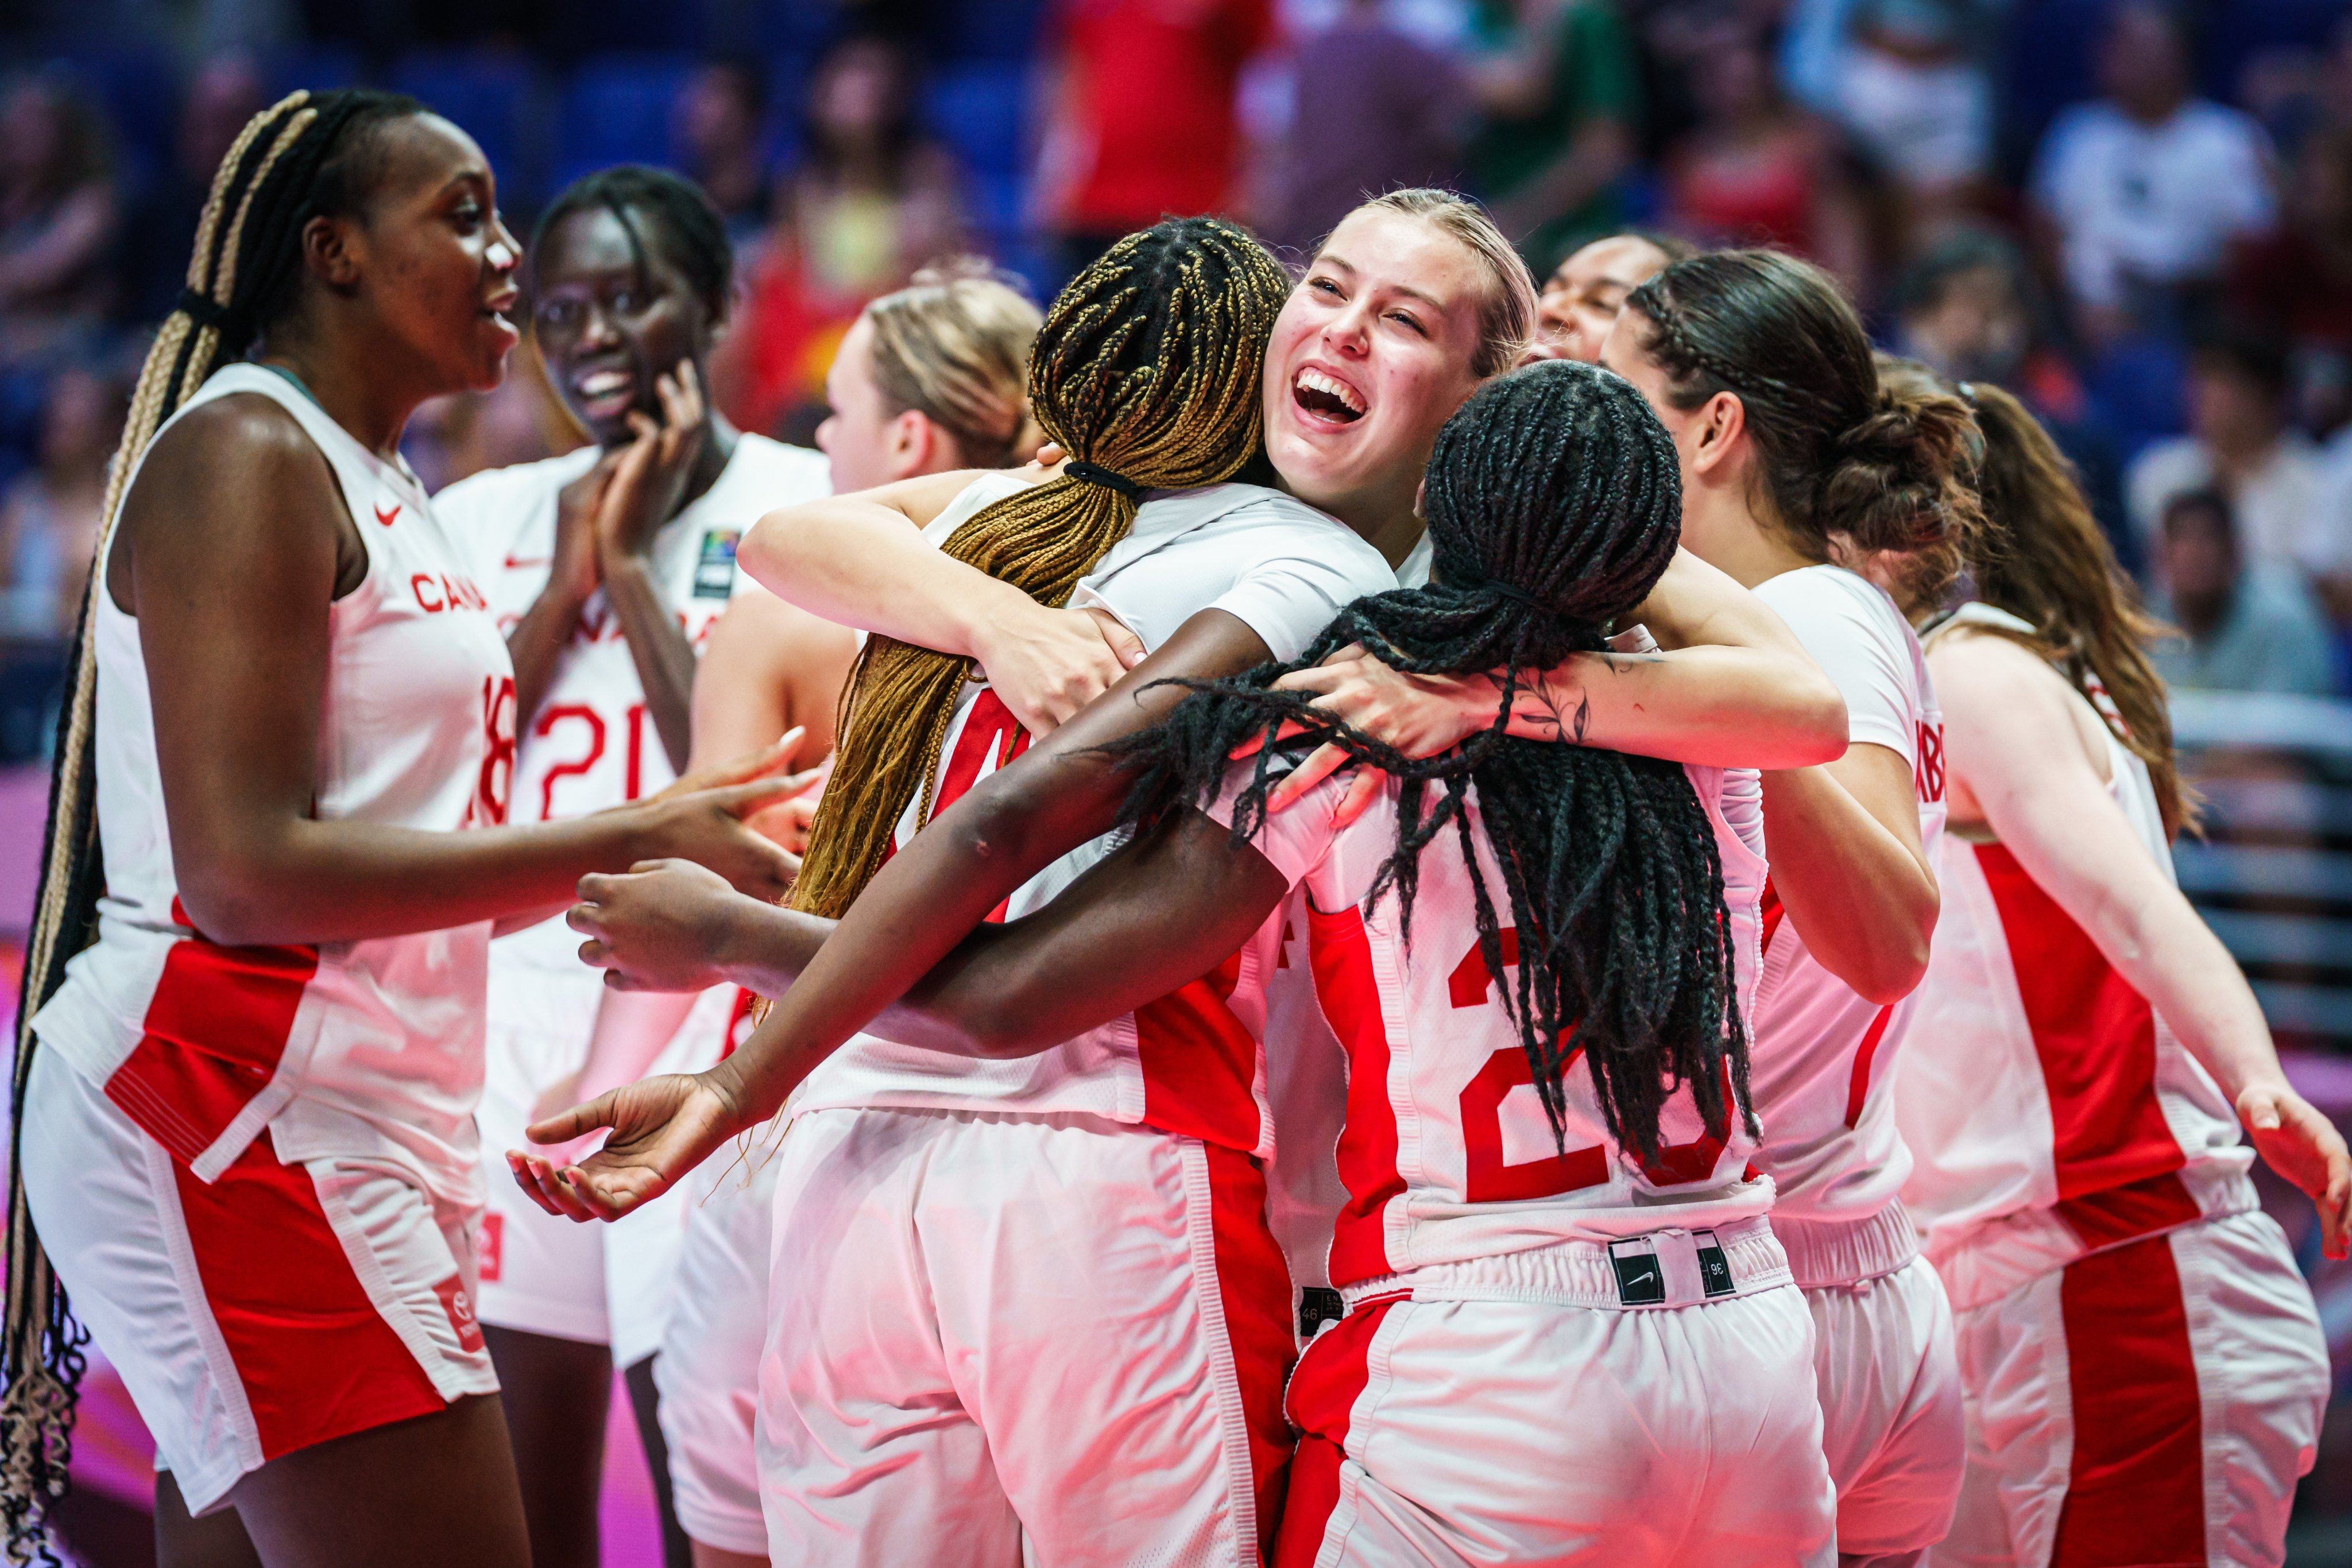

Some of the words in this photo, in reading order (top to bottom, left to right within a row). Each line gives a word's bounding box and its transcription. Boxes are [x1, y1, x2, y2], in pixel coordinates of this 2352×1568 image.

[465, 675, 515, 826] 18
[536, 704, 645, 820] 21
[1302, 1308, 1317, 1320] 46
